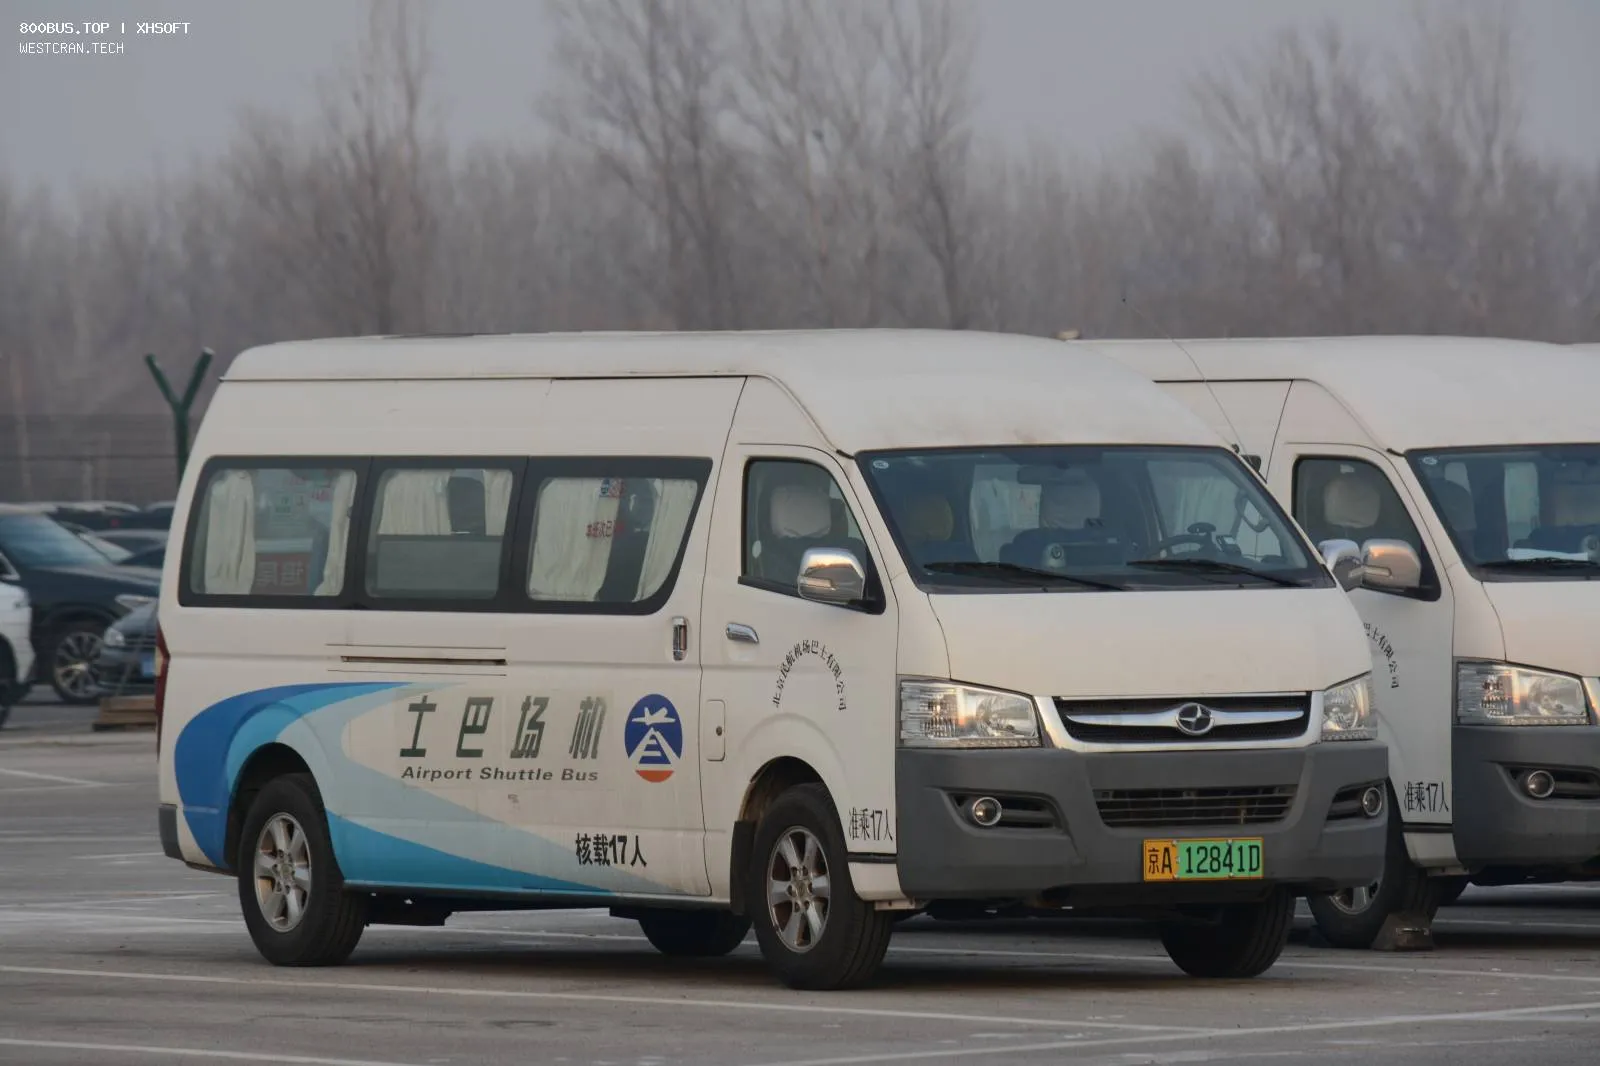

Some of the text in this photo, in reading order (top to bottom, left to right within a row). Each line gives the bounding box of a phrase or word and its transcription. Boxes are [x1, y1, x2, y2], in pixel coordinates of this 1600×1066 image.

[401, 766, 599, 782] Airport Shuttle Bus
[575, 833, 648, 867] 核载17人
[1148, 844, 1260, 874] 京A 12841D
